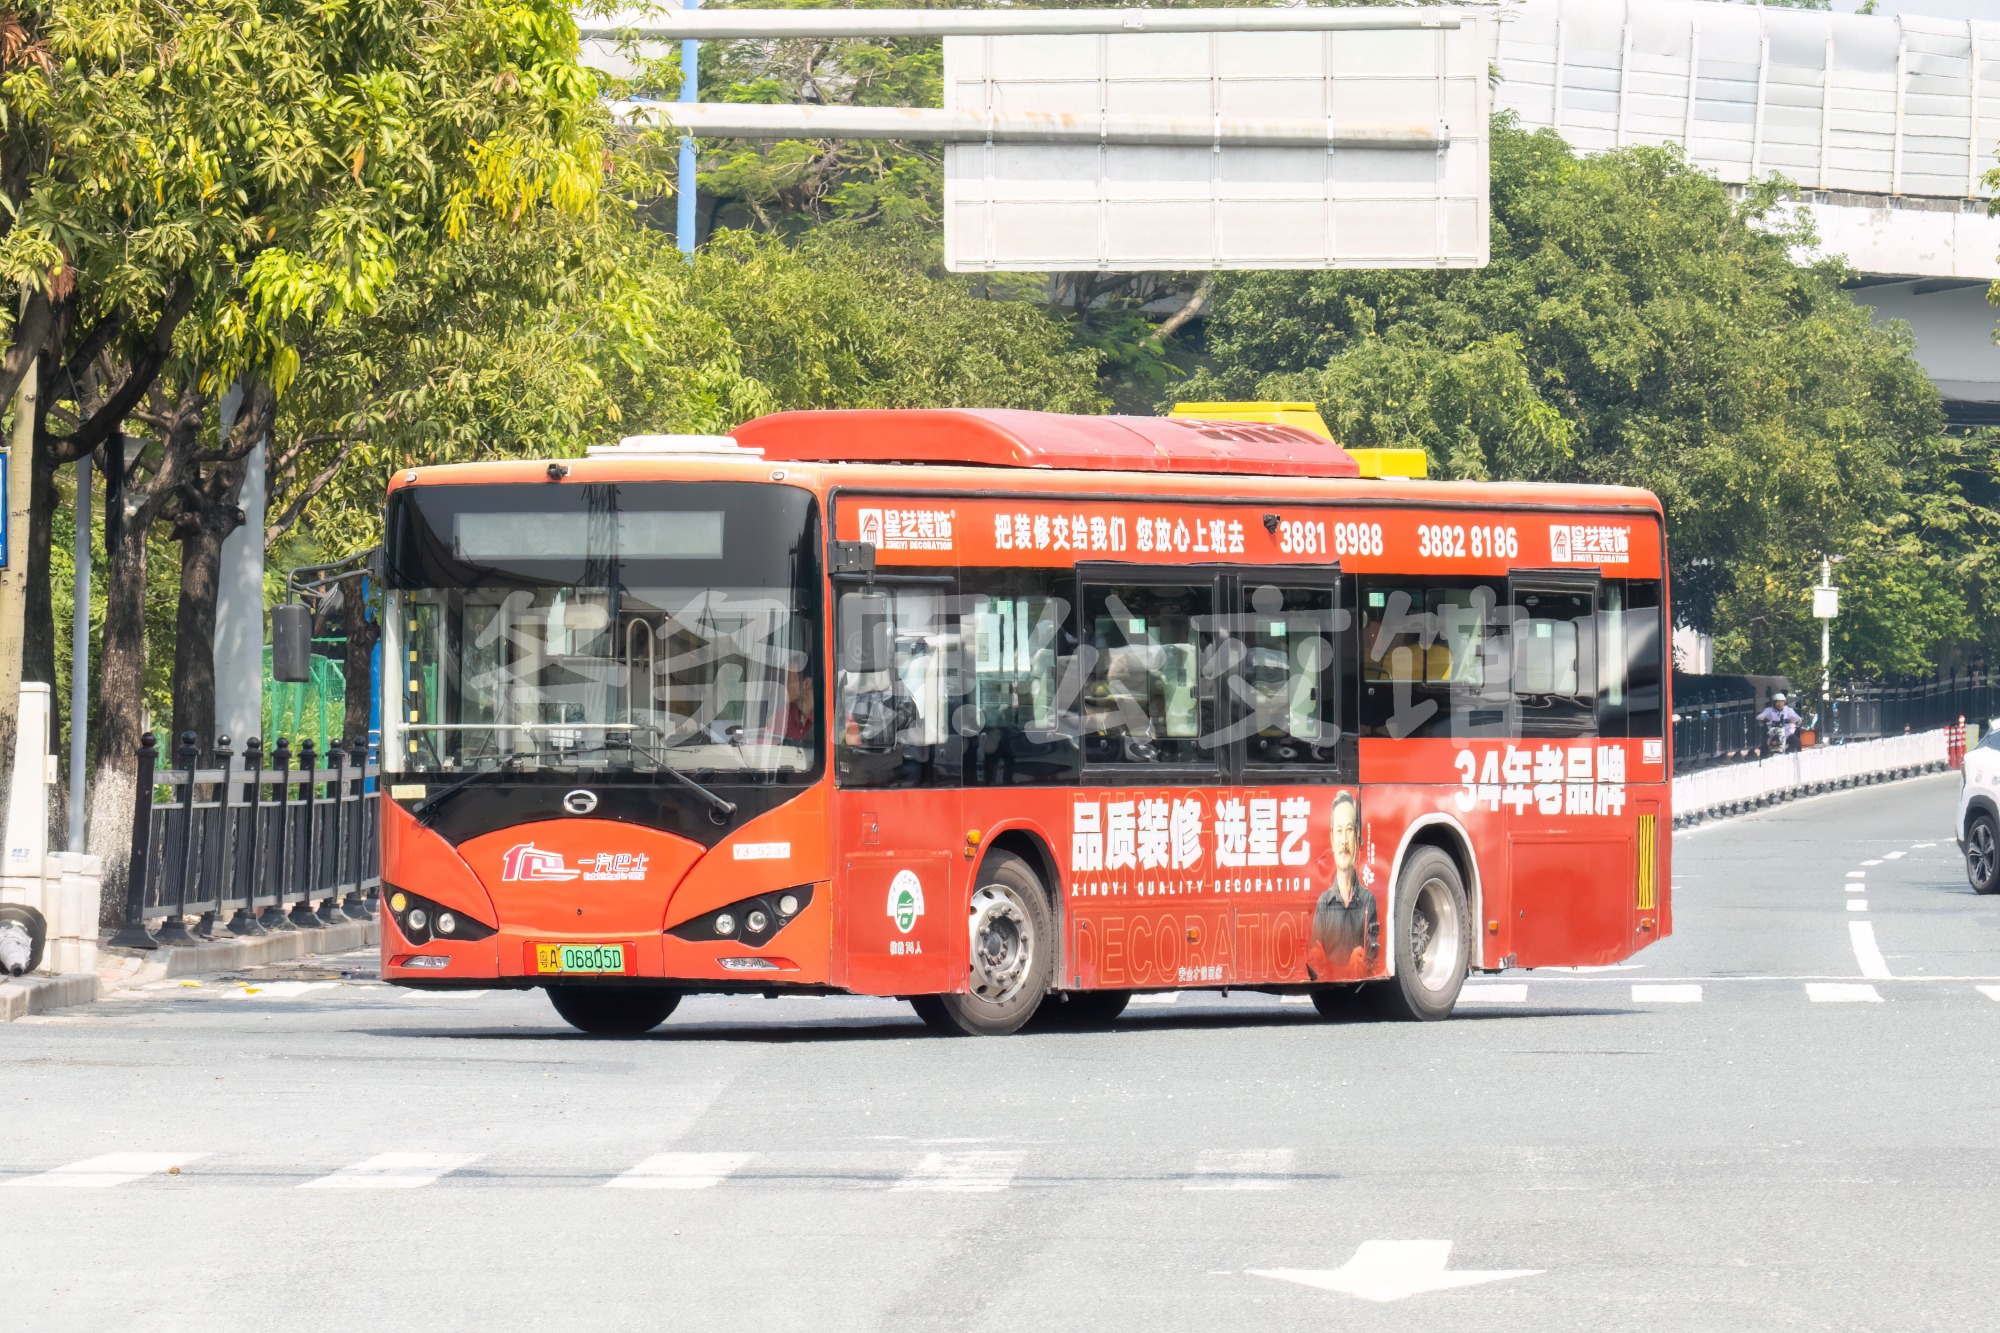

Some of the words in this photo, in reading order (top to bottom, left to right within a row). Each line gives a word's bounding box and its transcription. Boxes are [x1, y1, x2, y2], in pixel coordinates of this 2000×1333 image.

[884, 509, 952, 537] 星艺装饰
[995, 513, 1126, 552] 把装修交给我们
[1136, 516, 1245, 554] 您放心上班去
[1280, 521, 1326, 554] 3881
[1335, 523, 1383, 556] 8988
[1571, 526, 1629, 552] 星艺装饰
[909, 541, 953, 551] DECORATION
[1418, 525, 1465, 557] 3882
[1471, 526, 1518, 558] 8186
[1454, 744, 1626, 816] 34年老品牌
[1072, 798, 1203, 871] 品质装修
[1215, 796, 1311, 869] 选星艺
[578, 852, 650, 872] 一汽巴士
[1072, 882, 1127, 896] XINGYI
[1138, 881, 1203, 896] QUALITY
[1215, 878, 1311, 893] DECORATION
[1075, 911, 1308, 985] DECORATIO
